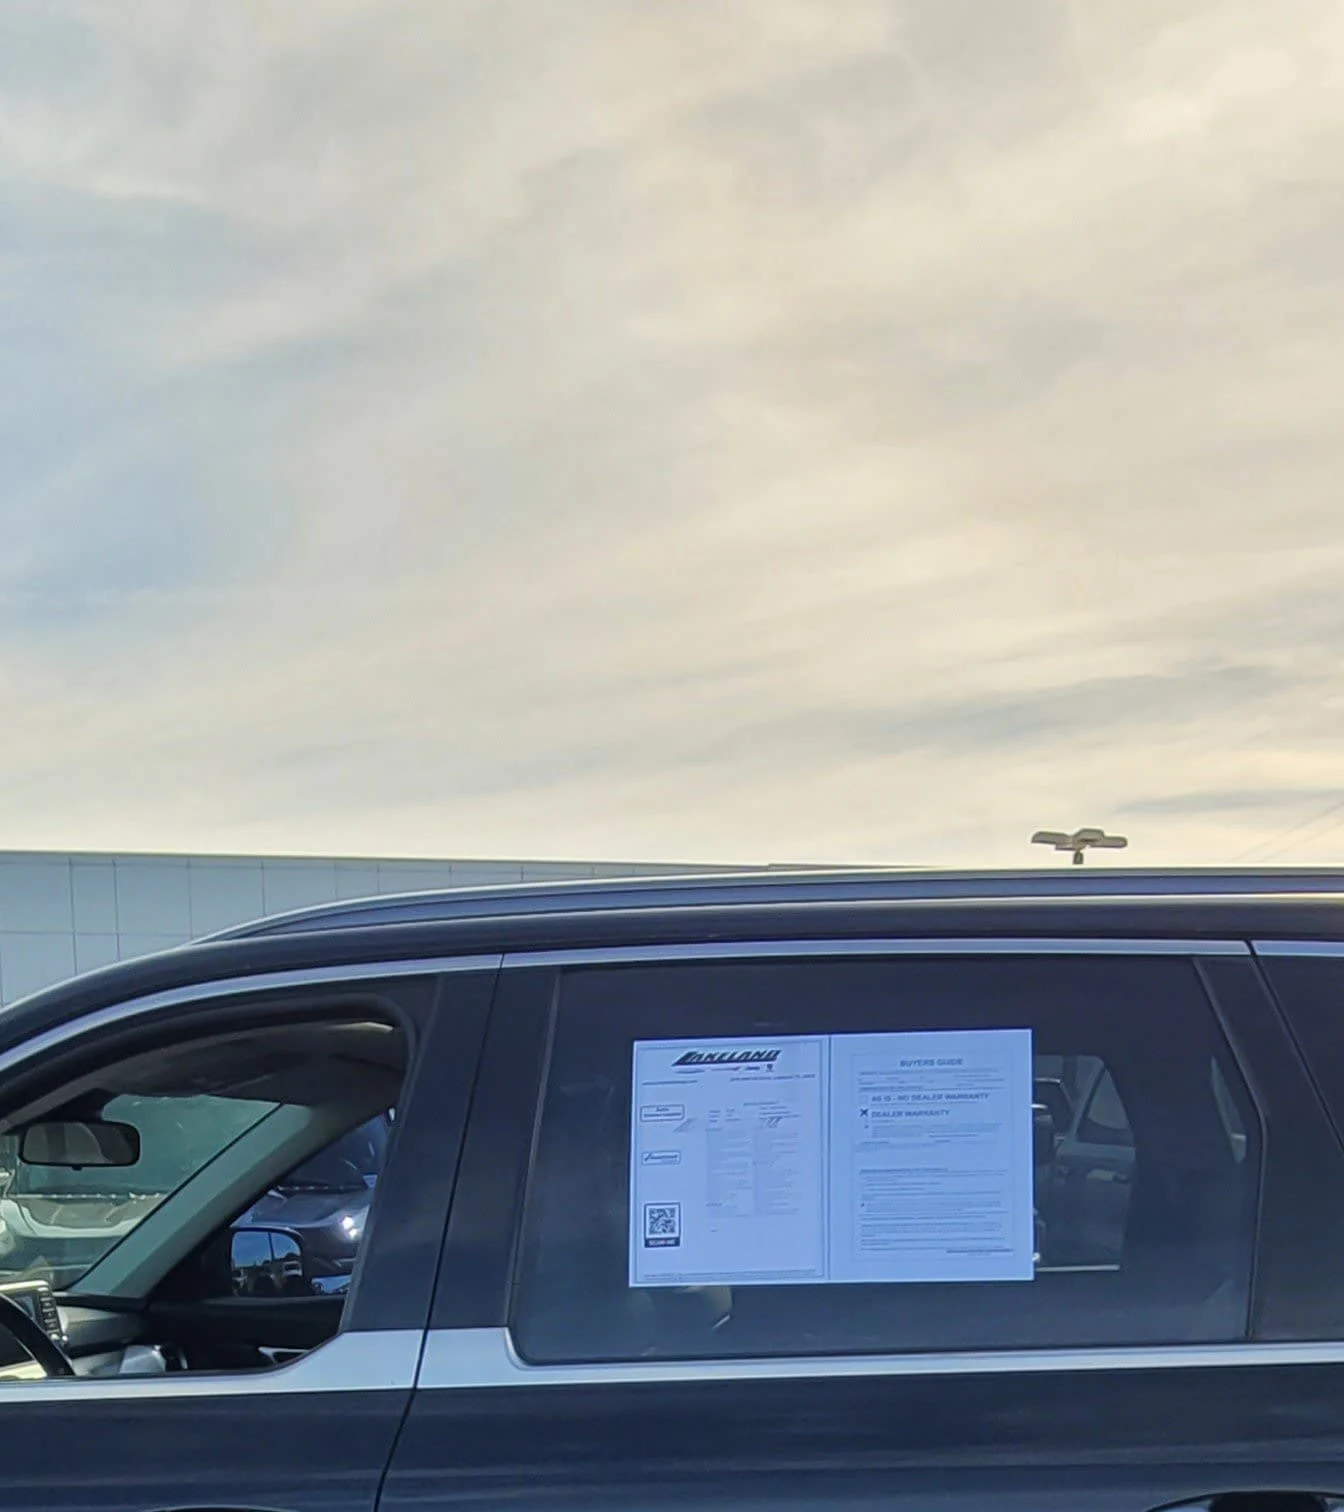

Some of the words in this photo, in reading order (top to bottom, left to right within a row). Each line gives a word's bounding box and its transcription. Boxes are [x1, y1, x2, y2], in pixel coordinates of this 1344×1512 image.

[672, 1050, 782, 1066] LAKELAND
[900, 1059, 935, 1068] BUYERS
[937, 1058, 964, 1066] GUIDE
[944, 1092, 990, 1100] WARRANTY
[905, 1109, 950, 1117] WARRANTY
